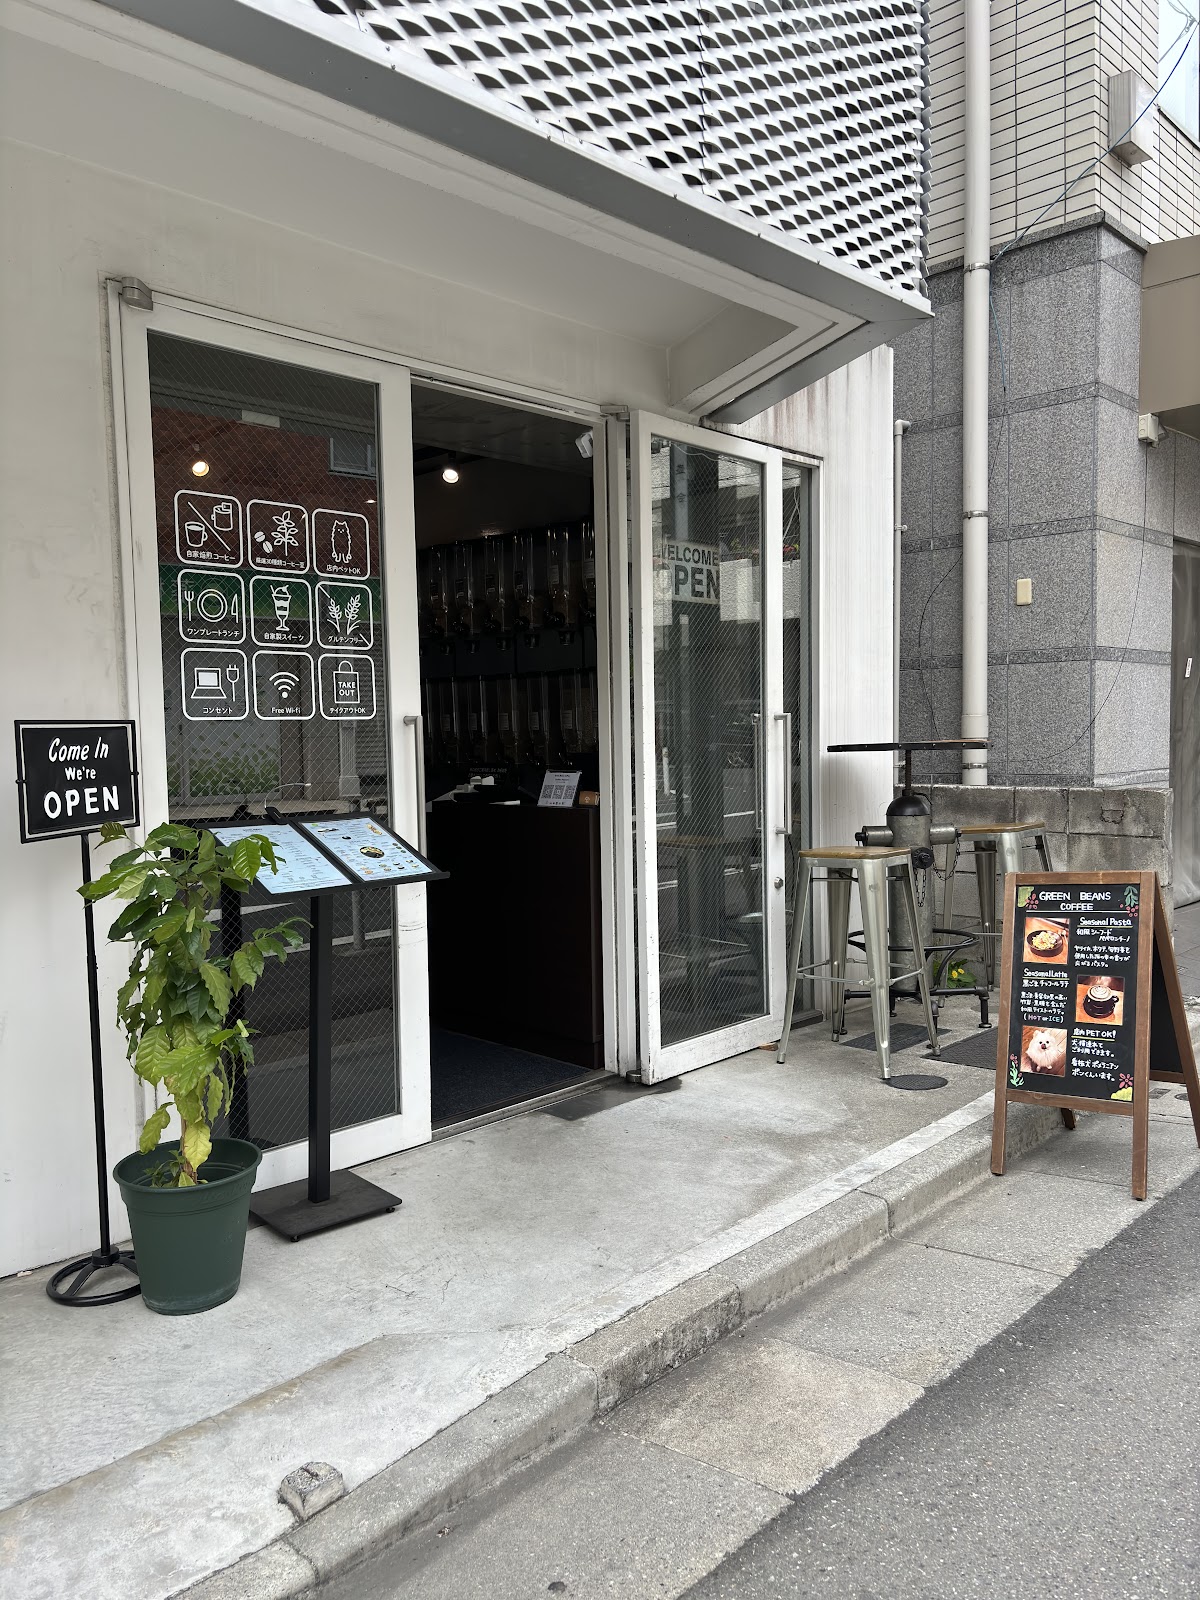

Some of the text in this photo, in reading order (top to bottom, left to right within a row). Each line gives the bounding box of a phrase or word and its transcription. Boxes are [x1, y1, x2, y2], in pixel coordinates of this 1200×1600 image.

[186, 550, 236, 561] 自家焙煎コーヒー
[326, 564, 361, 574] 店内ペットOK
[187, 628, 240, 637] ワンプレートランチ
[264, 632, 304, 641] 自家製スイーツ
[328, 635, 363, 643] グルテンフリー
[48, 736, 109, 762] Come In
[64, 766, 97, 780] We're
[44, 785, 120, 819] OPEN
[1039, 891, 1111, 901] GREEN BEANS
[1060, 903, 1094, 911] COFFEE
[1079, 916, 1132, 926] Seasonal Pasta
[1023, 967, 1068, 978] Seasonal Latte
[1085, 1029, 1100, 1037] PET
